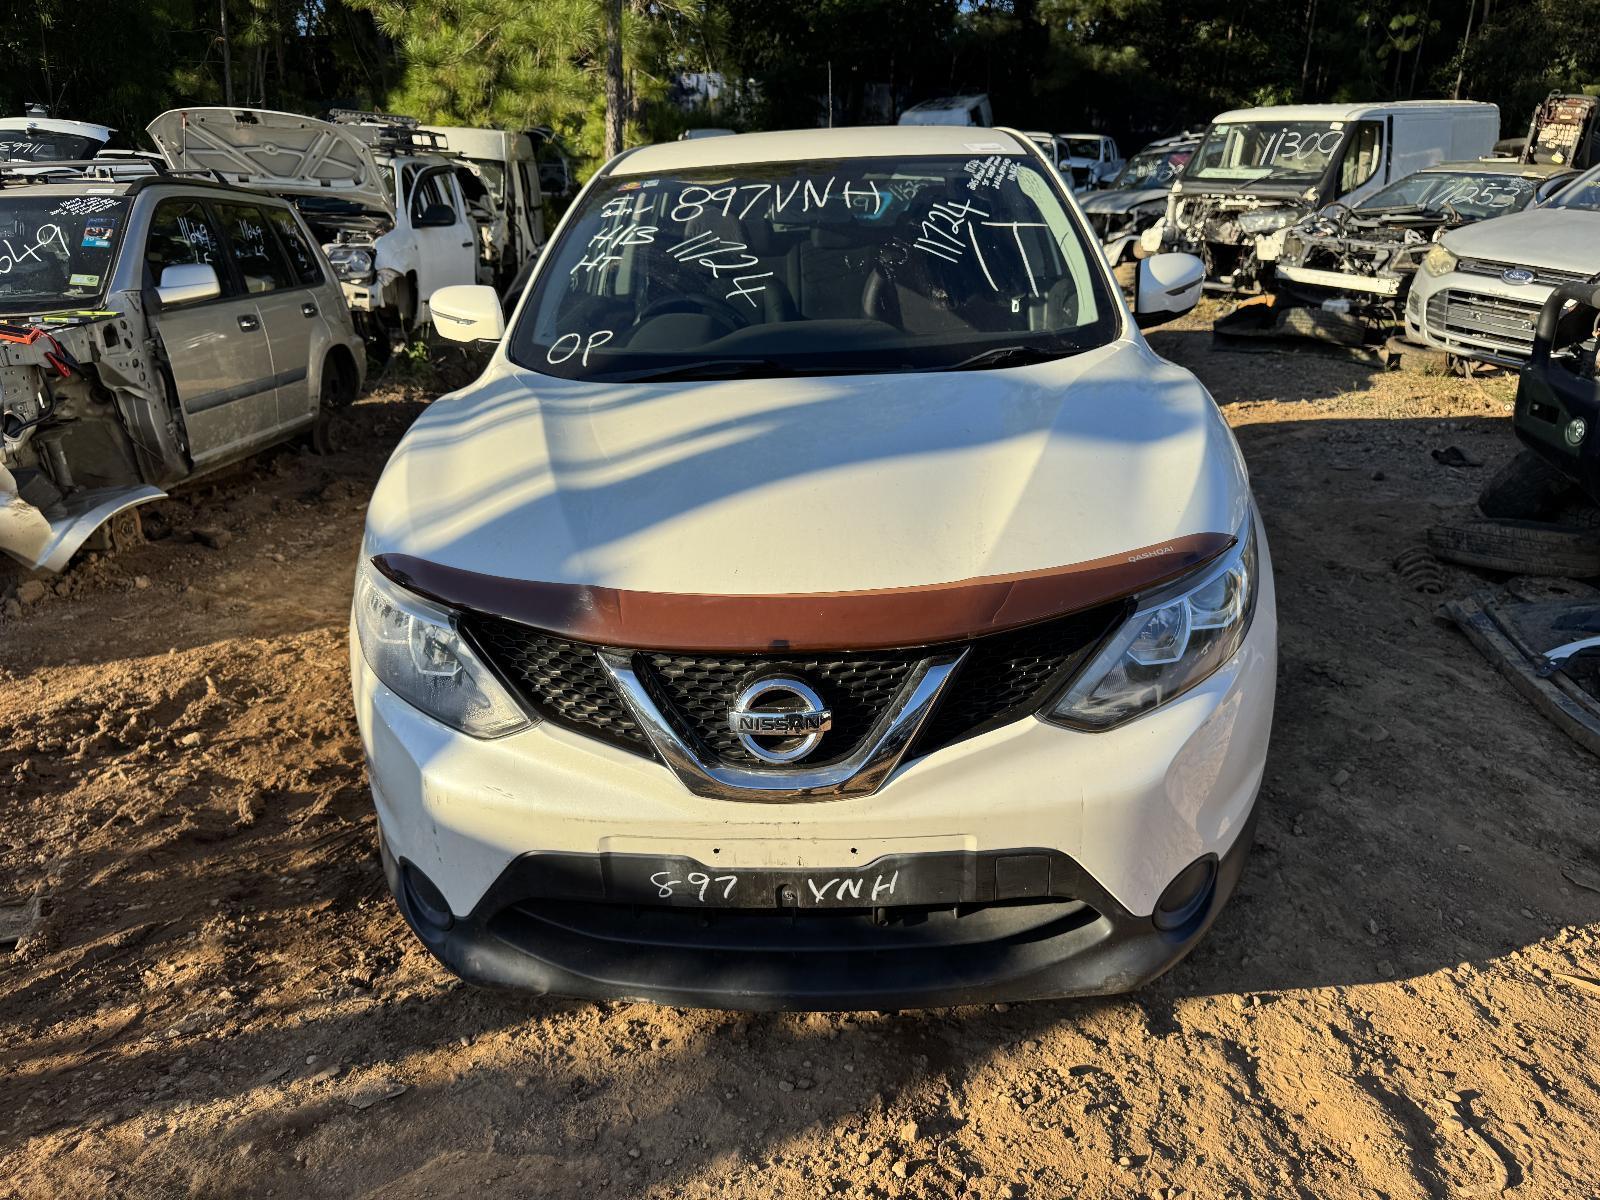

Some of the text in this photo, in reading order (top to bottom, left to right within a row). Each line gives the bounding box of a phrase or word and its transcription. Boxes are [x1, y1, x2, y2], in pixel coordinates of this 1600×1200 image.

[1259, 127, 1345, 167] 11309
[1429, 180, 1521, 208] 11253
[913, 199, 990, 264] 11724
[546, 330, 614, 367] OP
[1127, 545, 1175, 563] QASHQAI
[738, 715, 821, 732] NISSAN
[648, 871, 738, 902] 897
